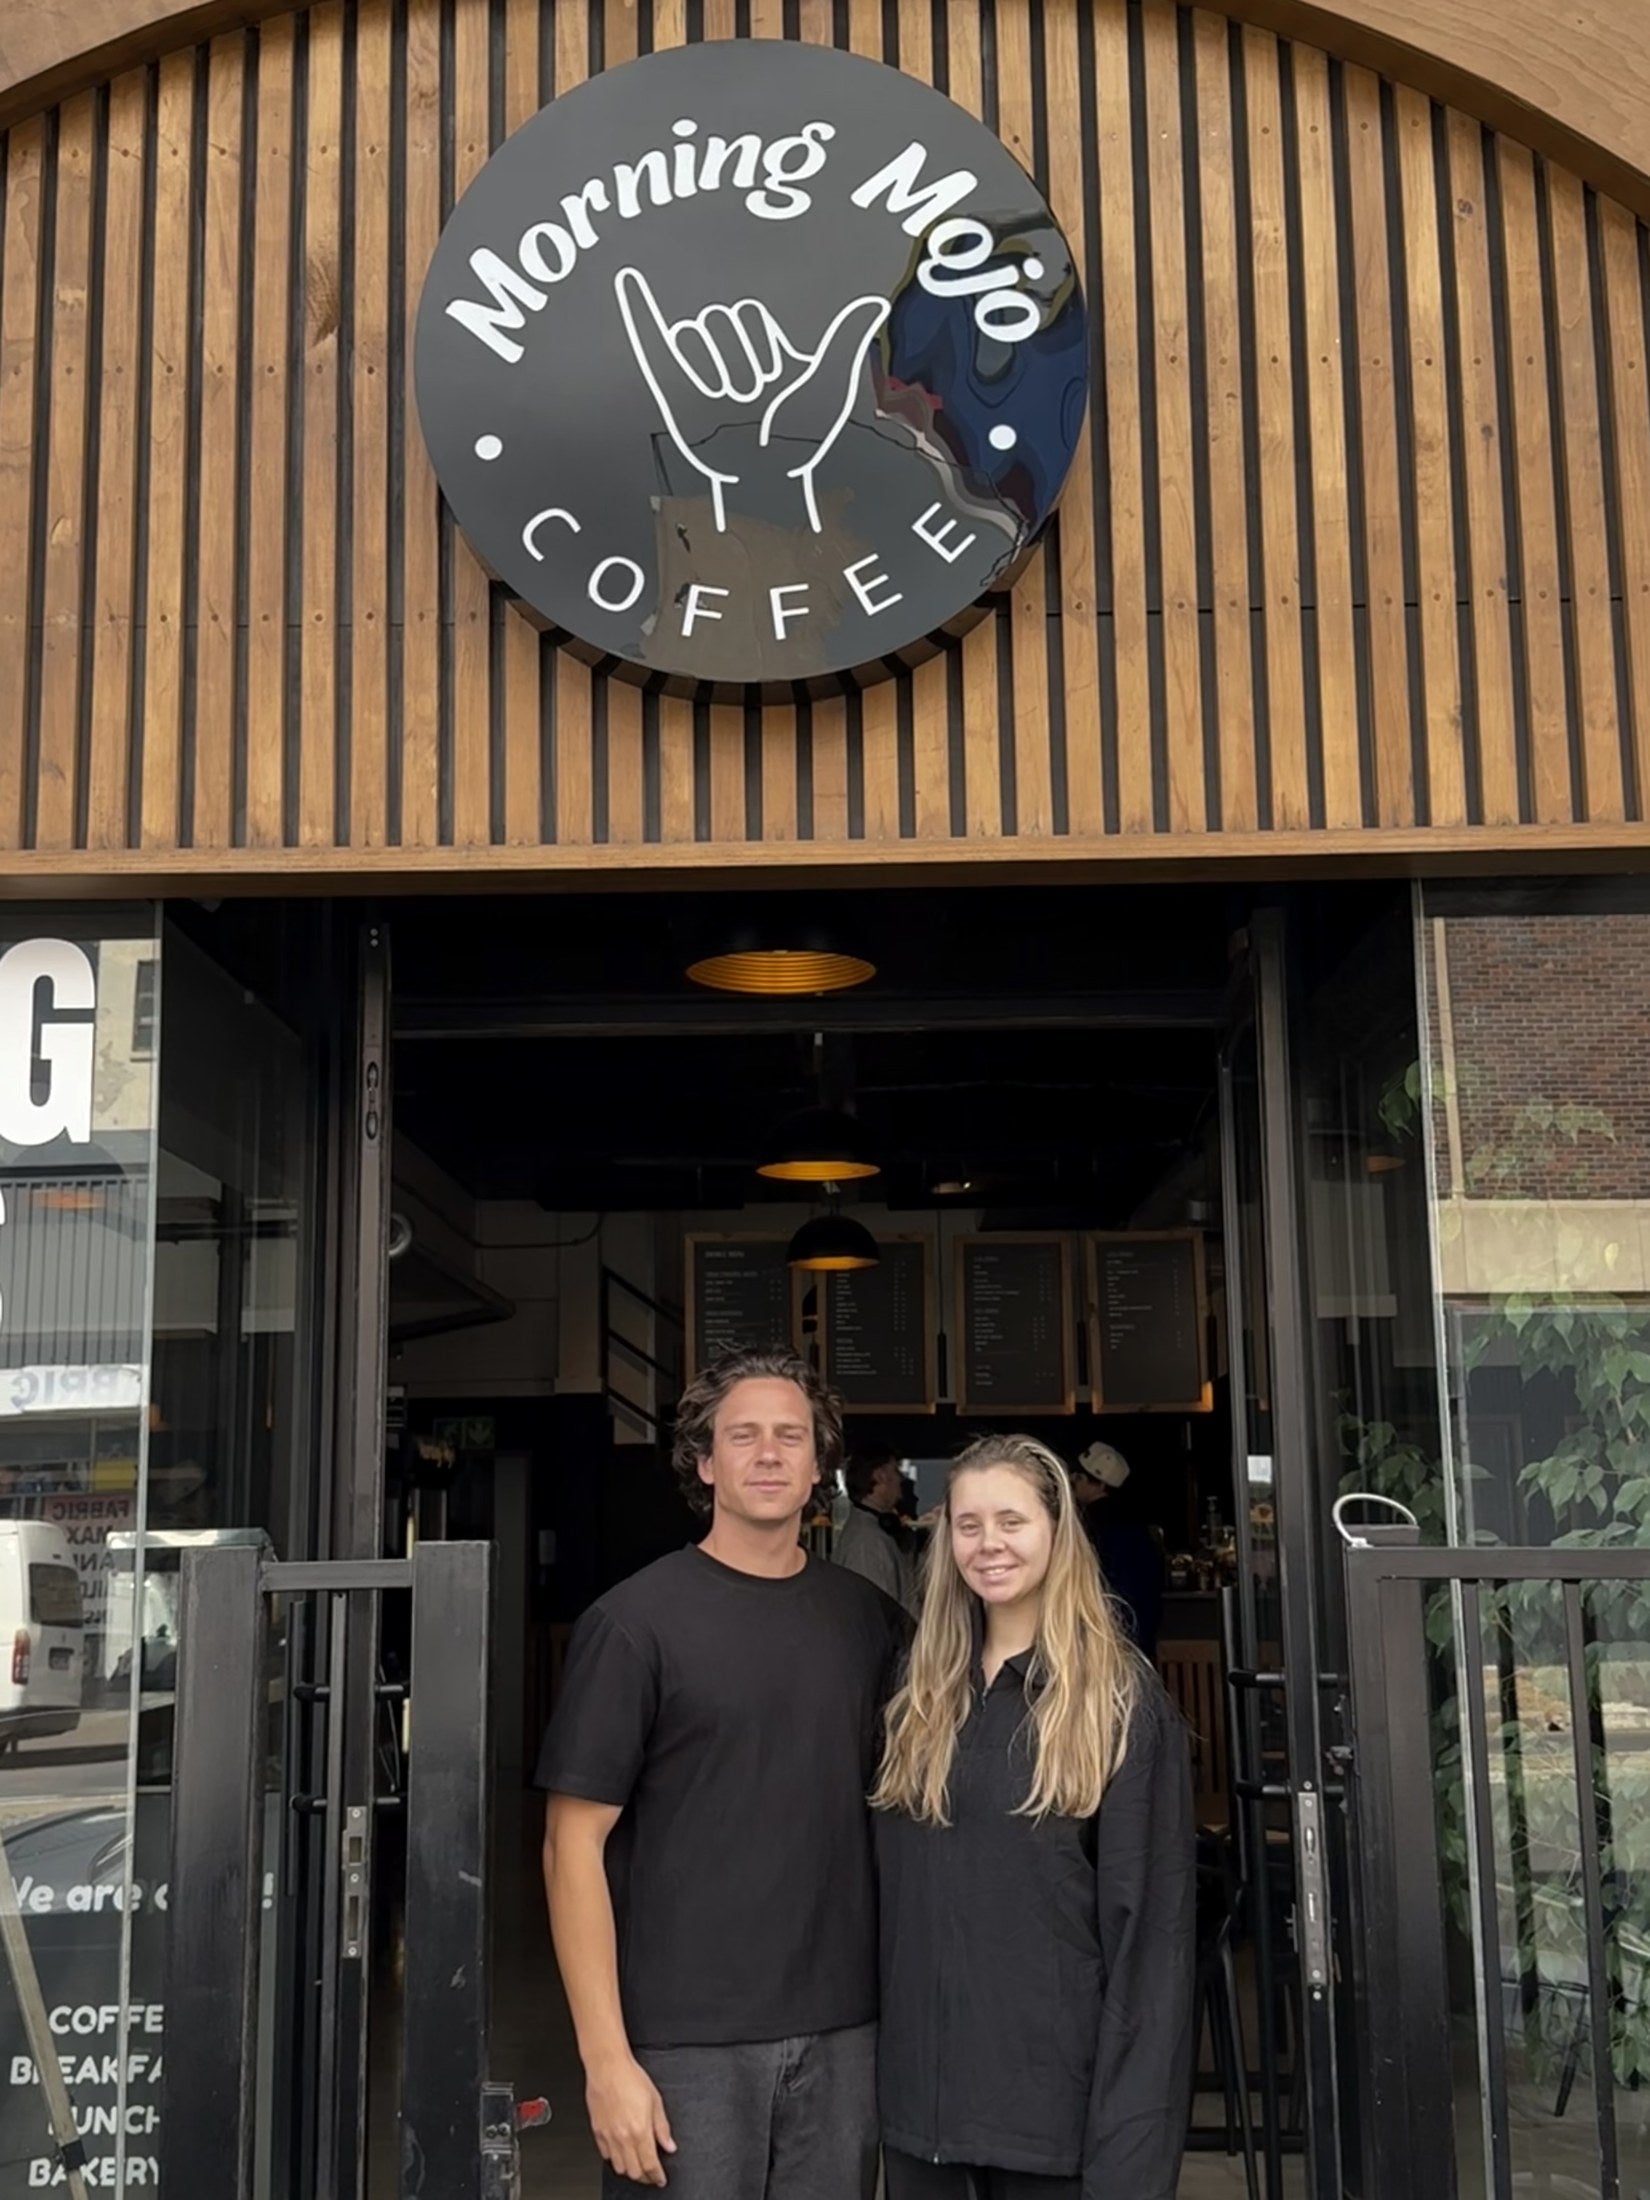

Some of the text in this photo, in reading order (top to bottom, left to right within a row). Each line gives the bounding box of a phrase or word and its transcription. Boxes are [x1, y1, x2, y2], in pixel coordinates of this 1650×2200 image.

[446, 118, 1040, 363] Morning Mojo
[522, 501, 976, 640] COFFEE
[66, 1884, 143, 1912] are
[48, 2105, 160, 2135] UNCH
